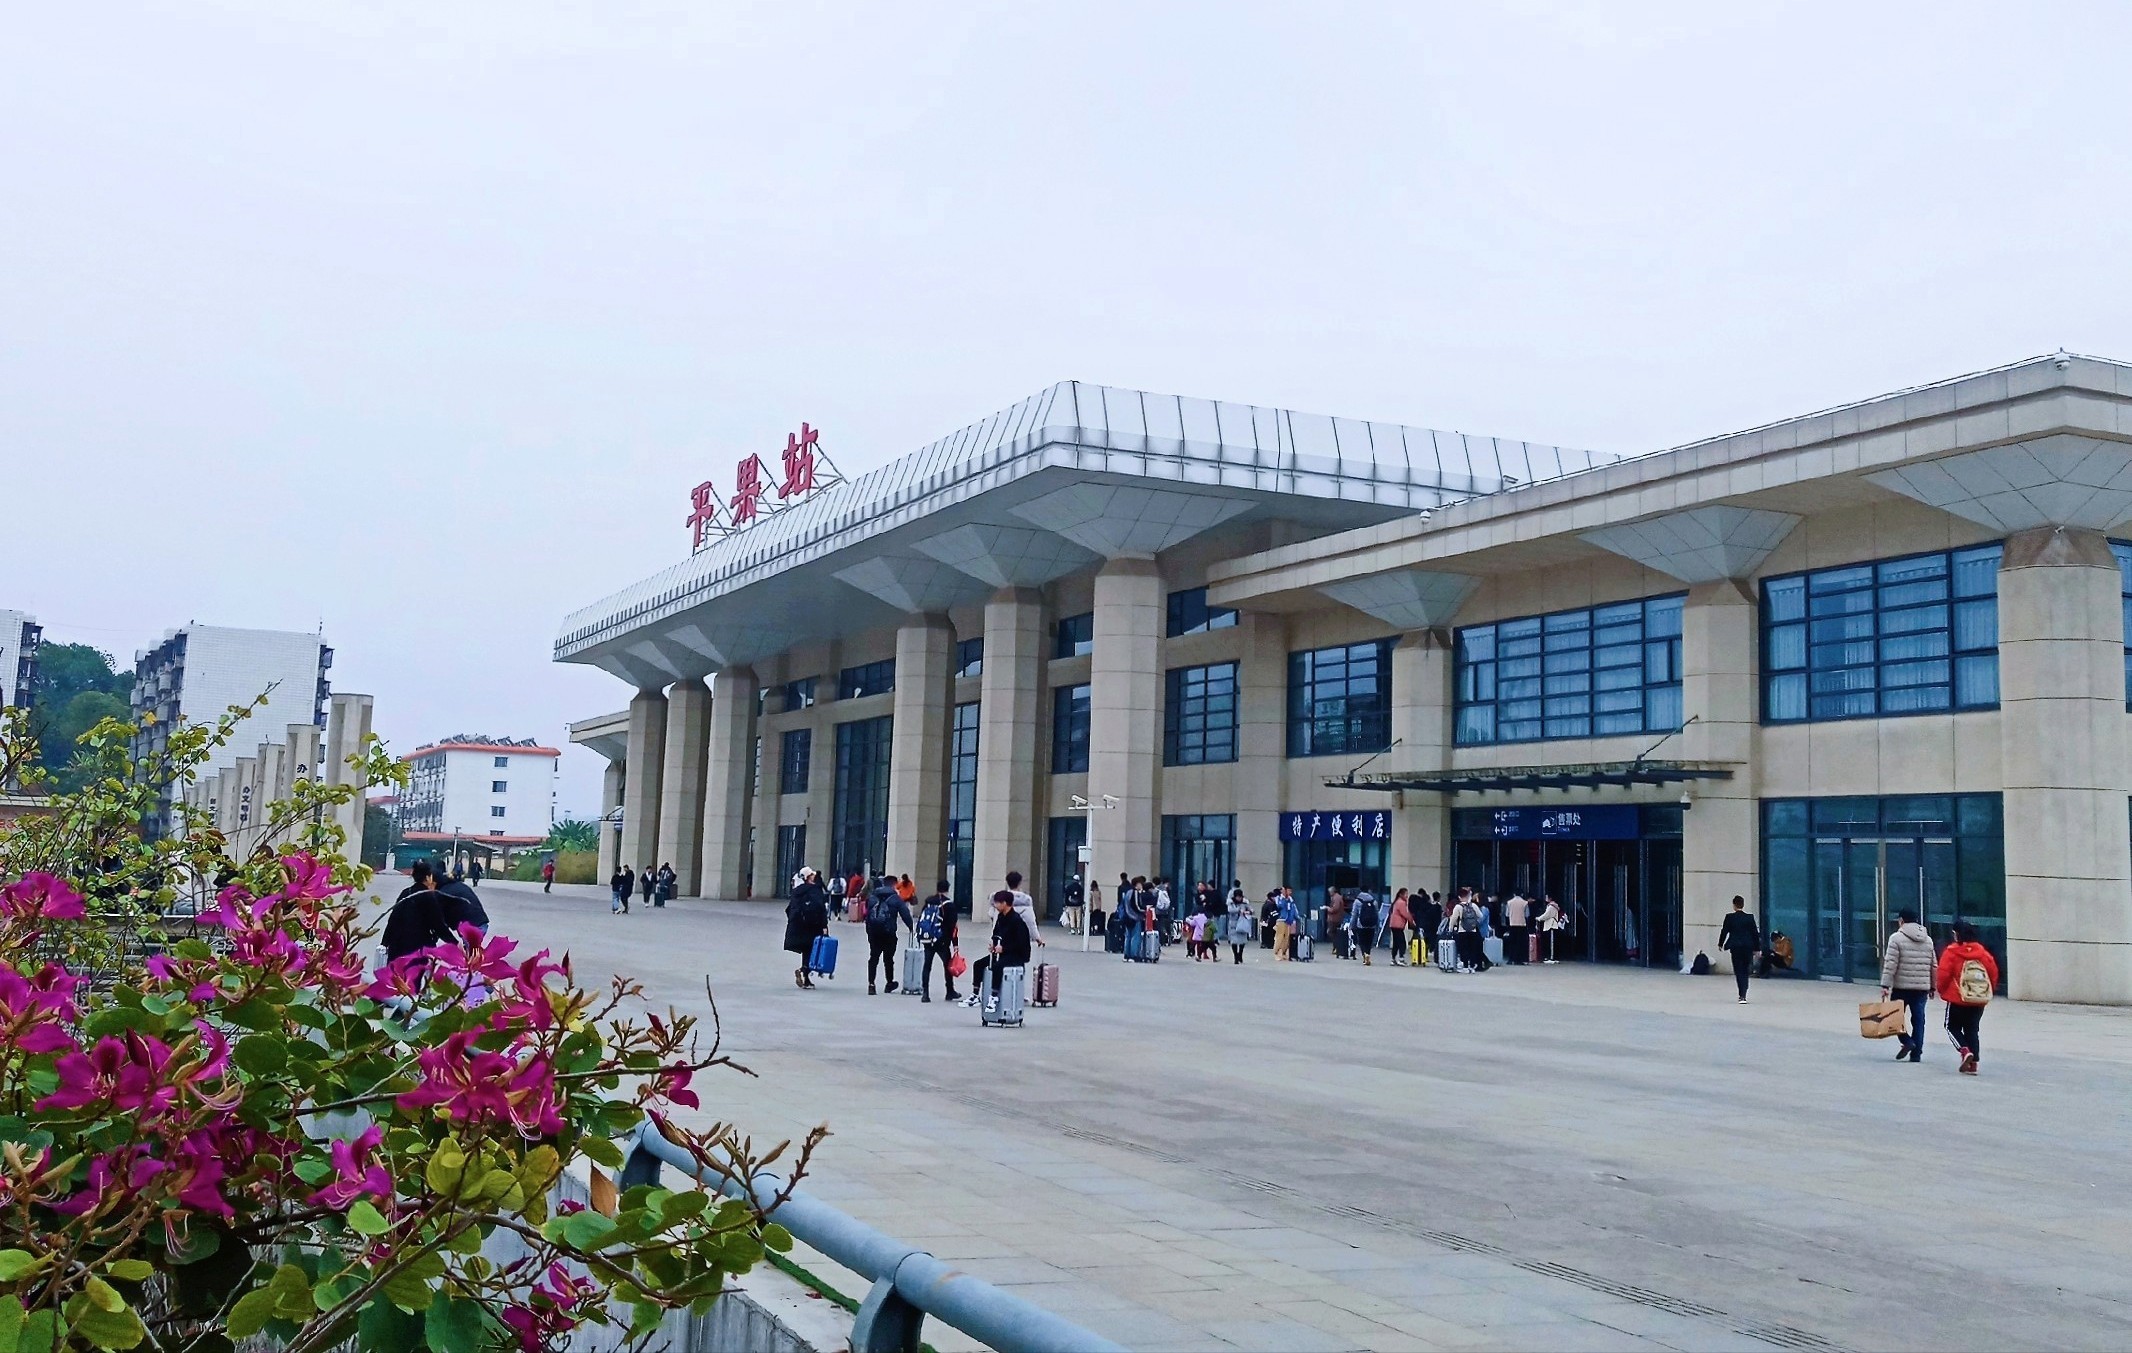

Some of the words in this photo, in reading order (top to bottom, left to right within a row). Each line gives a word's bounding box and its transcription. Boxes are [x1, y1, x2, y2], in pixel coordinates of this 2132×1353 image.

[685, 422, 818, 547] 平果站
[1292, 812, 1385, 839] 特产便利店
[1558, 812, 1581, 826] 售票处
